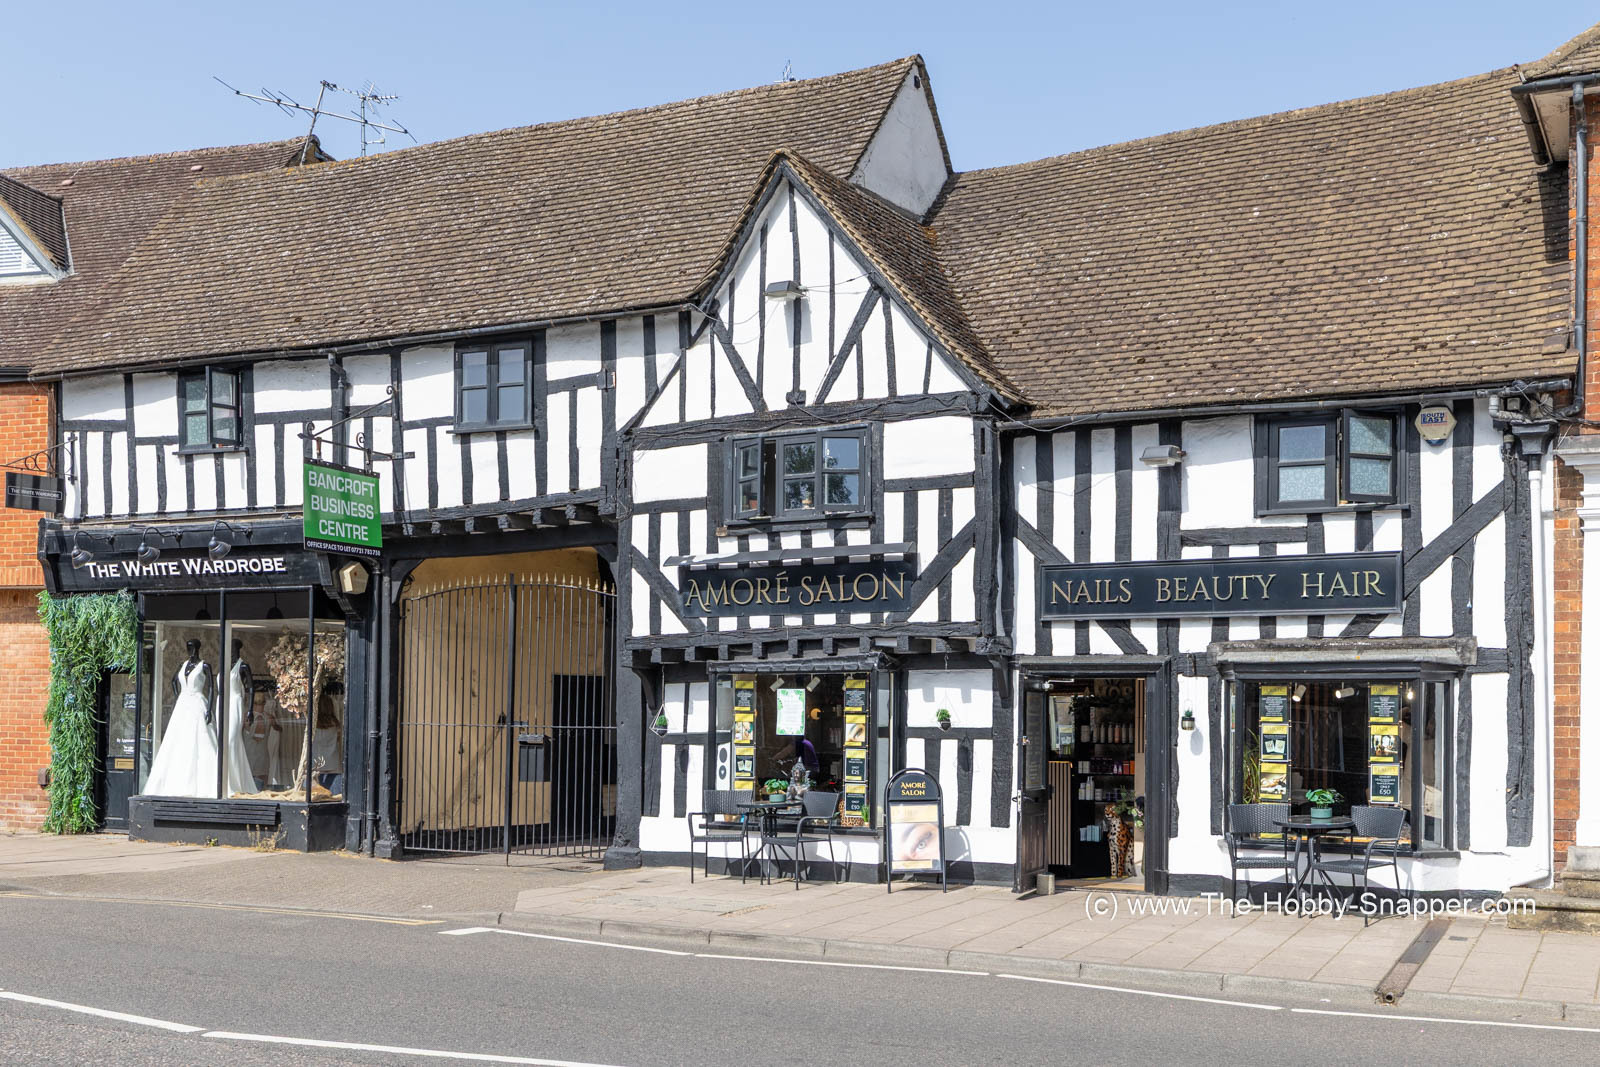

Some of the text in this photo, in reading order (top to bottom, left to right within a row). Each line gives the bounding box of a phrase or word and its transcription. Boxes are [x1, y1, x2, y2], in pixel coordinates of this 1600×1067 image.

[308, 470, 375, 498] BANCROFT
[311, 495, 374, 520] BUSINESS
[319, 519, 369, 541] CENTRE
[306, 541, 322, 549] OFFICE
[322, 542, 337, 551] SPACE
[85, 557, 286, 578] THE WHITE WARDROBE
[685, 570, 906, 612] AMORÉ SALON
[1051, 570, 1386, 605] NAILS BEAUTY HAIR
[901, 781, 926, 789] AMORÉ
